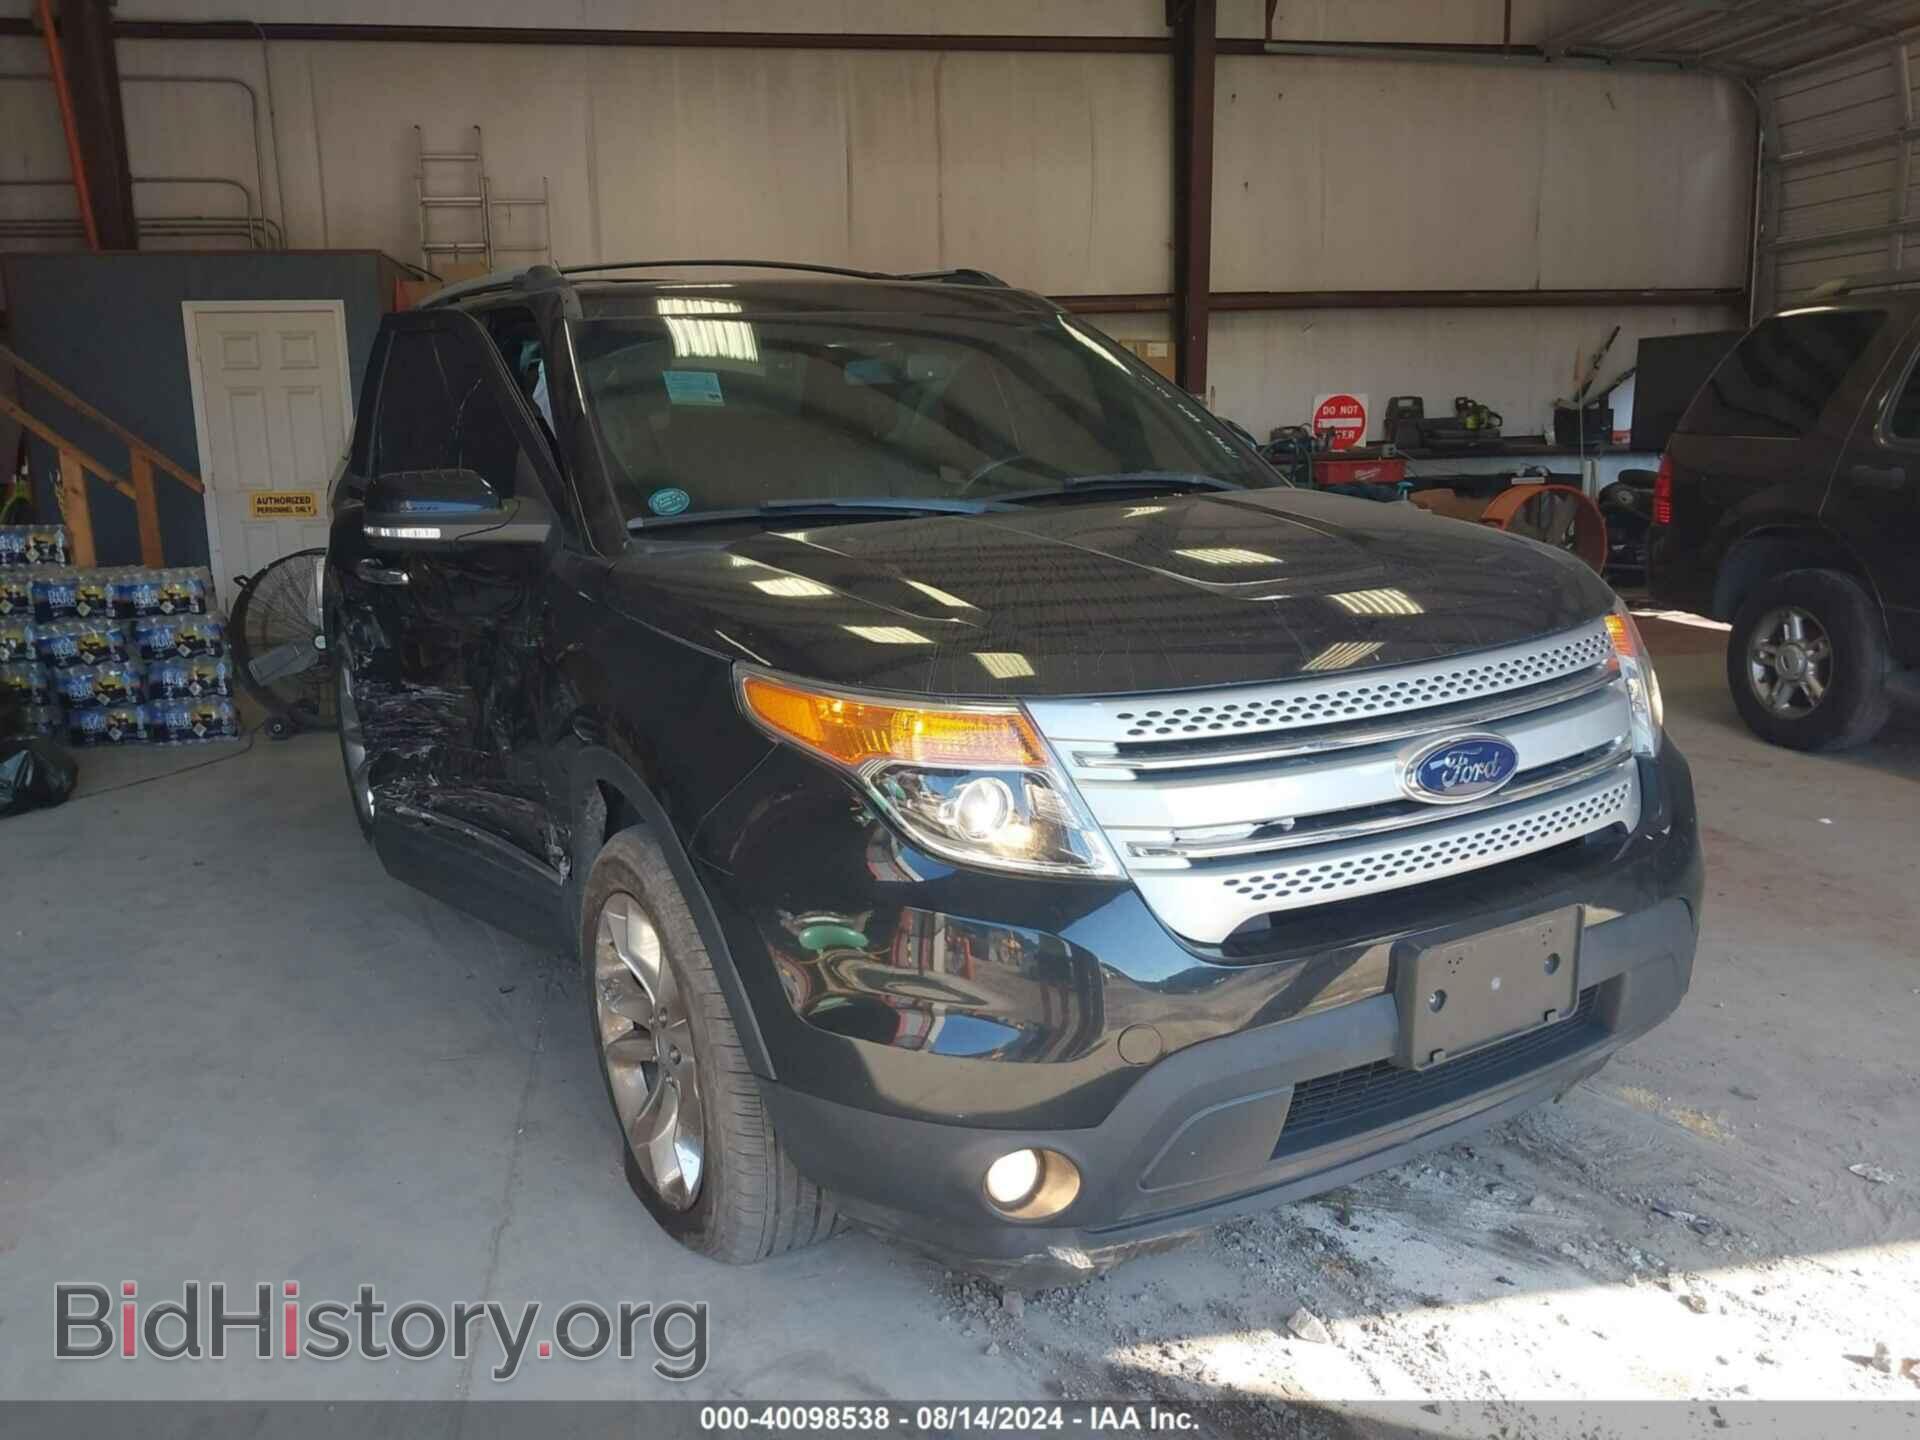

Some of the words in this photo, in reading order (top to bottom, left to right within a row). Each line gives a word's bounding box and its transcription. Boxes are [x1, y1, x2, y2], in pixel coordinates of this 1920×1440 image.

[1322, 405, 1337, 416] DO
[1339, 404, 1359, 416] NOT
[256, 495, 312, 505] AUTHORIZED
[1441, 746, 1502, 788] Ford
